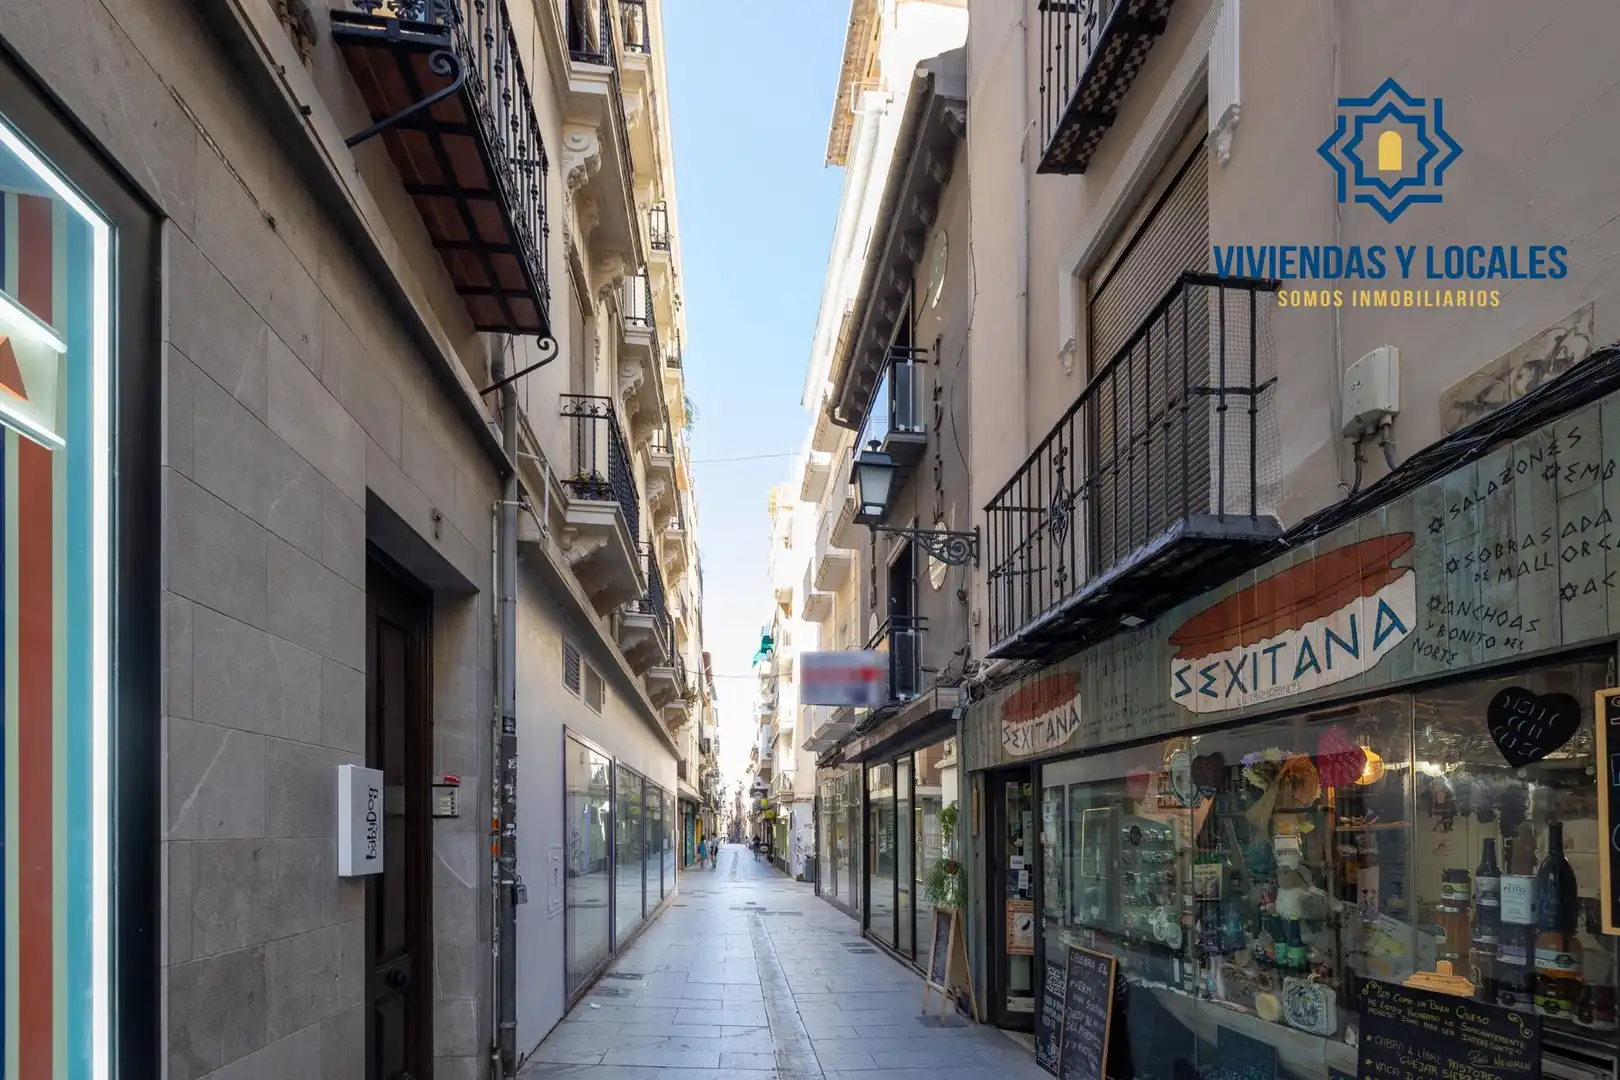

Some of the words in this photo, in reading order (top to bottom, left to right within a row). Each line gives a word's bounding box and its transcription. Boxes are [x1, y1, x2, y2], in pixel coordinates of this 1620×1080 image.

[1450, 426, 1582, 520] SALAZONES
[1465, 508, 1612, 567] SOBRASADA
[1498, 533, 1620, 582] MALLORC
[1436, 625, 1495, 649] BONITO
[1441, 599, 1540, 632] ANCHOAS
[1175, 598, 1408, 698] SEXITANA
[1003, 705, 1080, 750] SEXITANA
